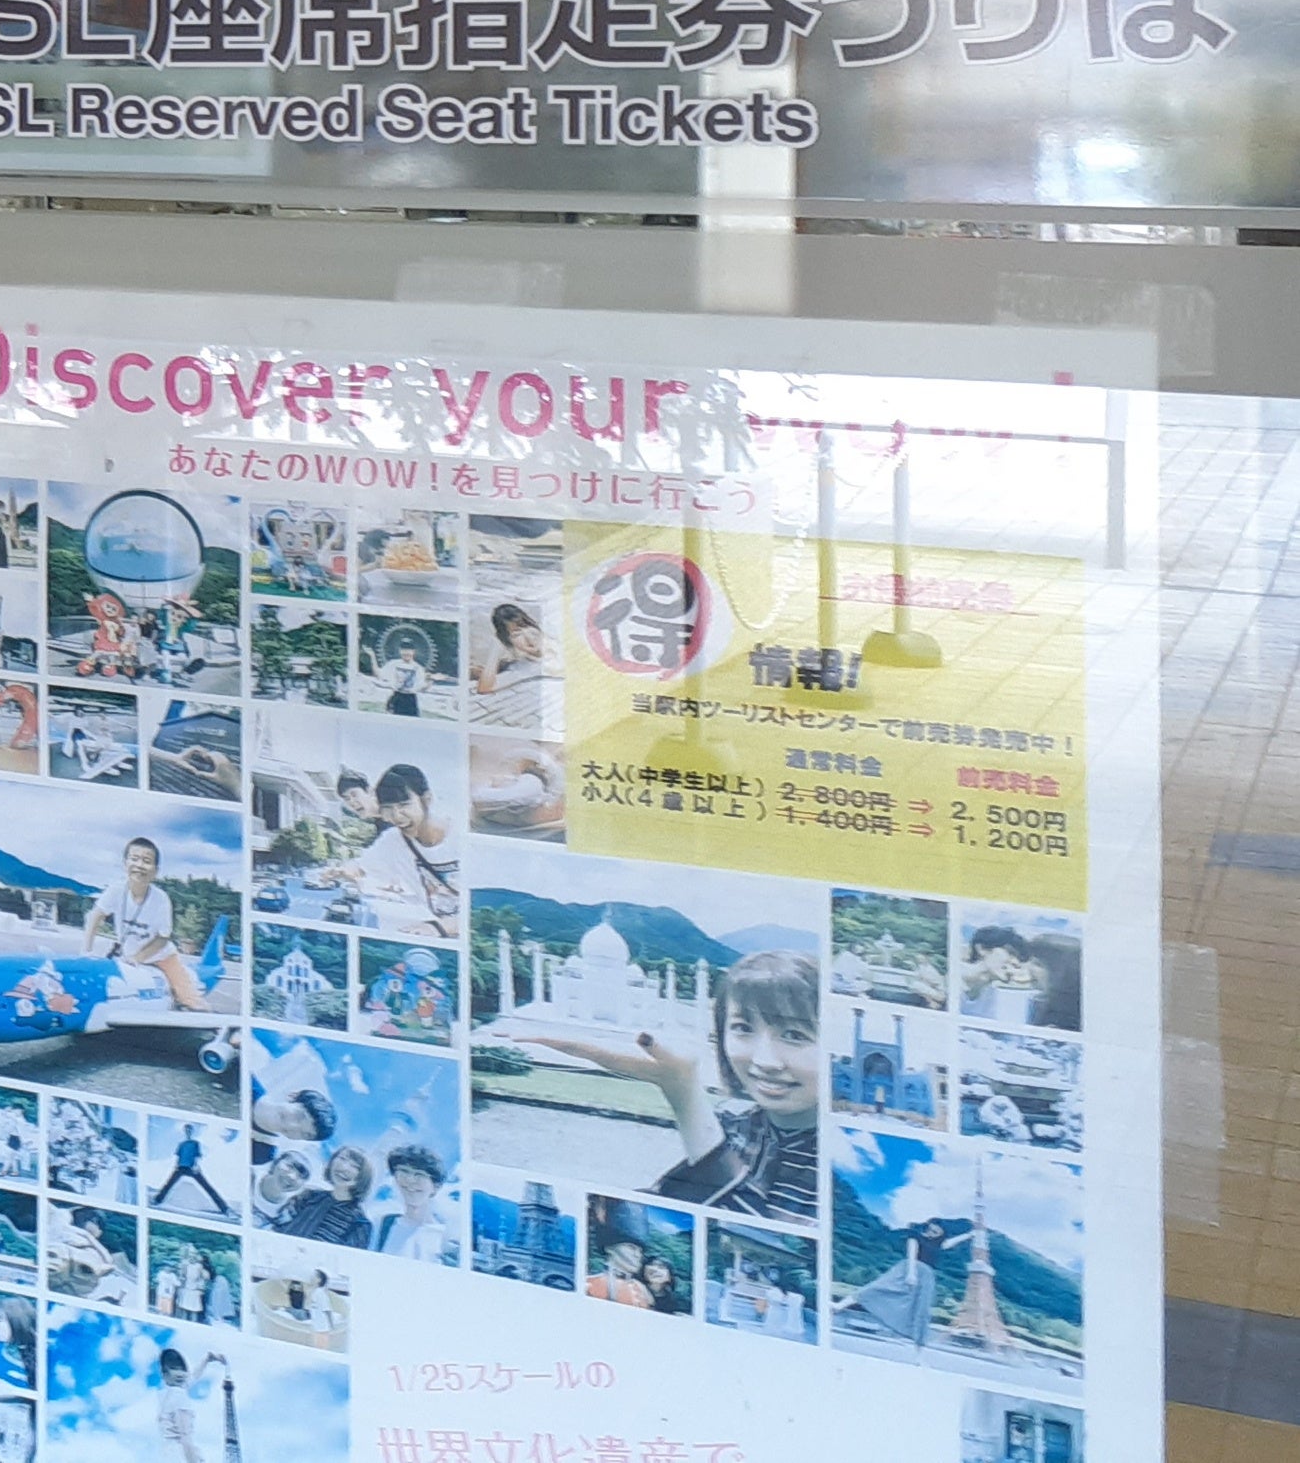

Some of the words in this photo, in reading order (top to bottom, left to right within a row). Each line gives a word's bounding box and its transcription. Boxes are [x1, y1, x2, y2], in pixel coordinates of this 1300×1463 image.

[70, 85, 363, 142] Reserved
[391, 86, 532, 144] Seat
[551, 86, 818, 148] Tickets
[431, 365, 692, 449] your
[784, 747, 884, 778] 通常料金
[956, 766, 1062, 799] 前売料金
[387, 1360, 618, 1394] 1/25スケールの
